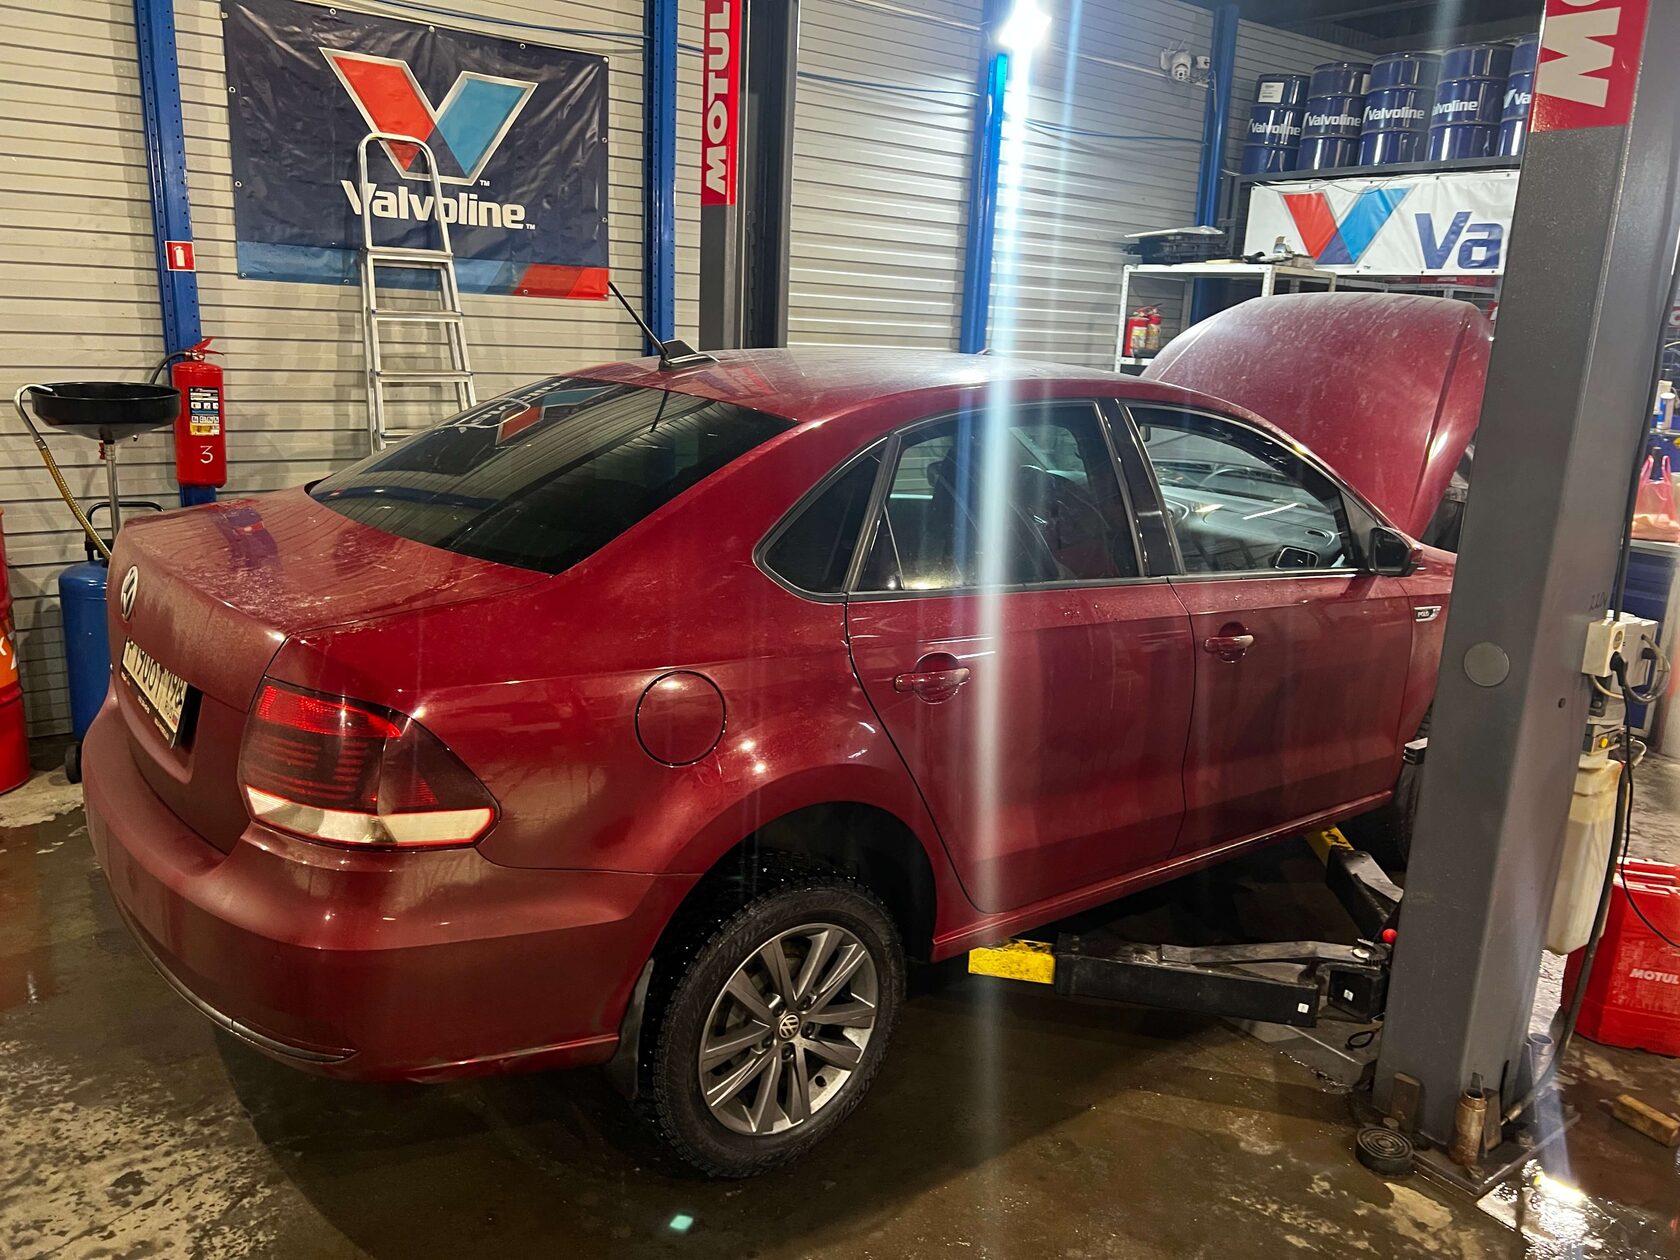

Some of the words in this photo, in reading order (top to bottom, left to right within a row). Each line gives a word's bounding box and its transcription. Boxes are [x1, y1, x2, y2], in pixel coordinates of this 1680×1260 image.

[1535, 0, 1621, 108] M
[706, 1, 730, 195] MOTUL
[1308, 113, 1361, 127] Valvoline
[1368, 106, 1424, 120] Valvoline
[1251, 121, 1300, 136] Valvoline
[340, 179, 526, 230] Valvoline
[200, 445, 213, 464] 3
[1629, 968, 1680, 985] MOTUL
